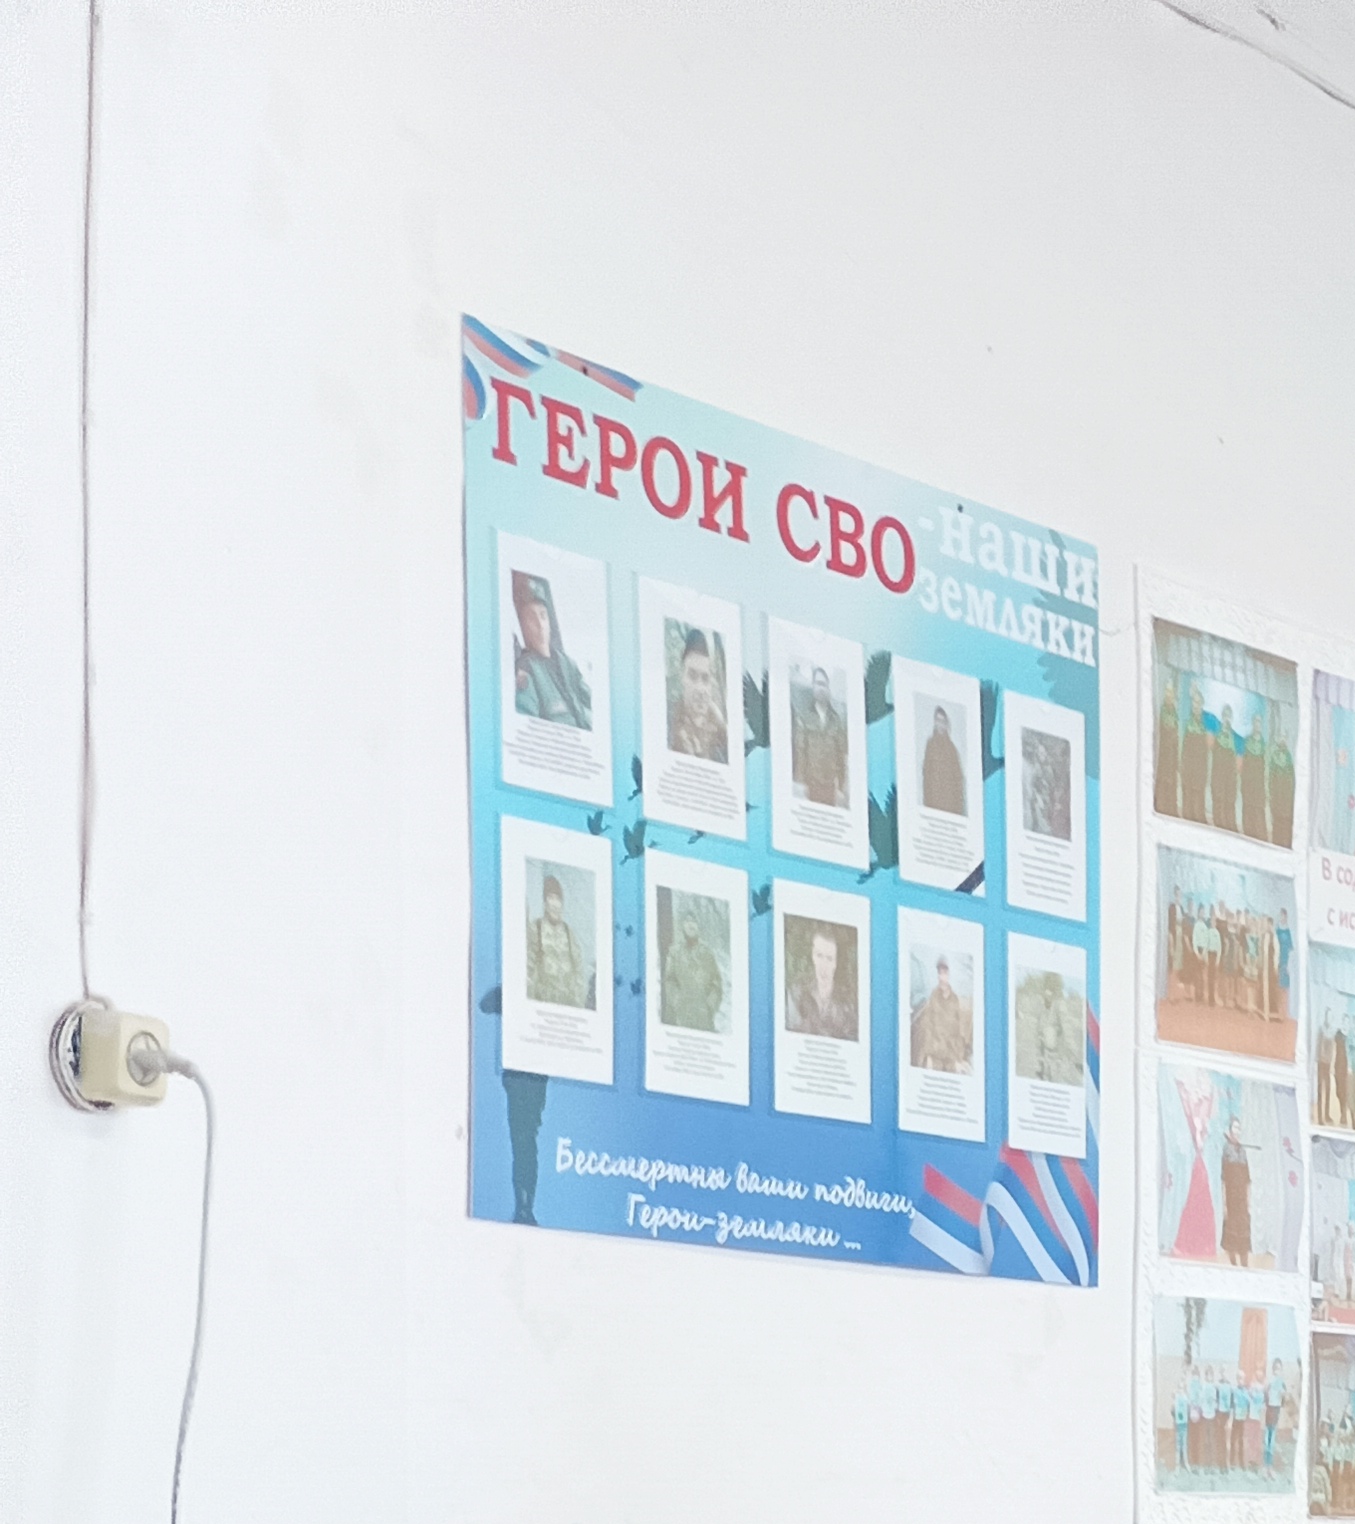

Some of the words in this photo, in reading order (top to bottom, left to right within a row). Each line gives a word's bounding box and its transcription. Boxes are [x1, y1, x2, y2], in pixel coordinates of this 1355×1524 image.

[490, 376, 749, 543] ГЕРОИ
[776, 483, 916, 594] СВО
[919, 566, 1097, 668] земляки
[1321, 857, 1332, 880] В
[1327, 907, 1336, 926] с
[555, 1137, 732, 1192] Бессмертны
[735, 1162, 810, 1201] ваши
[814, 1176, 917, 1220] подвиги,
